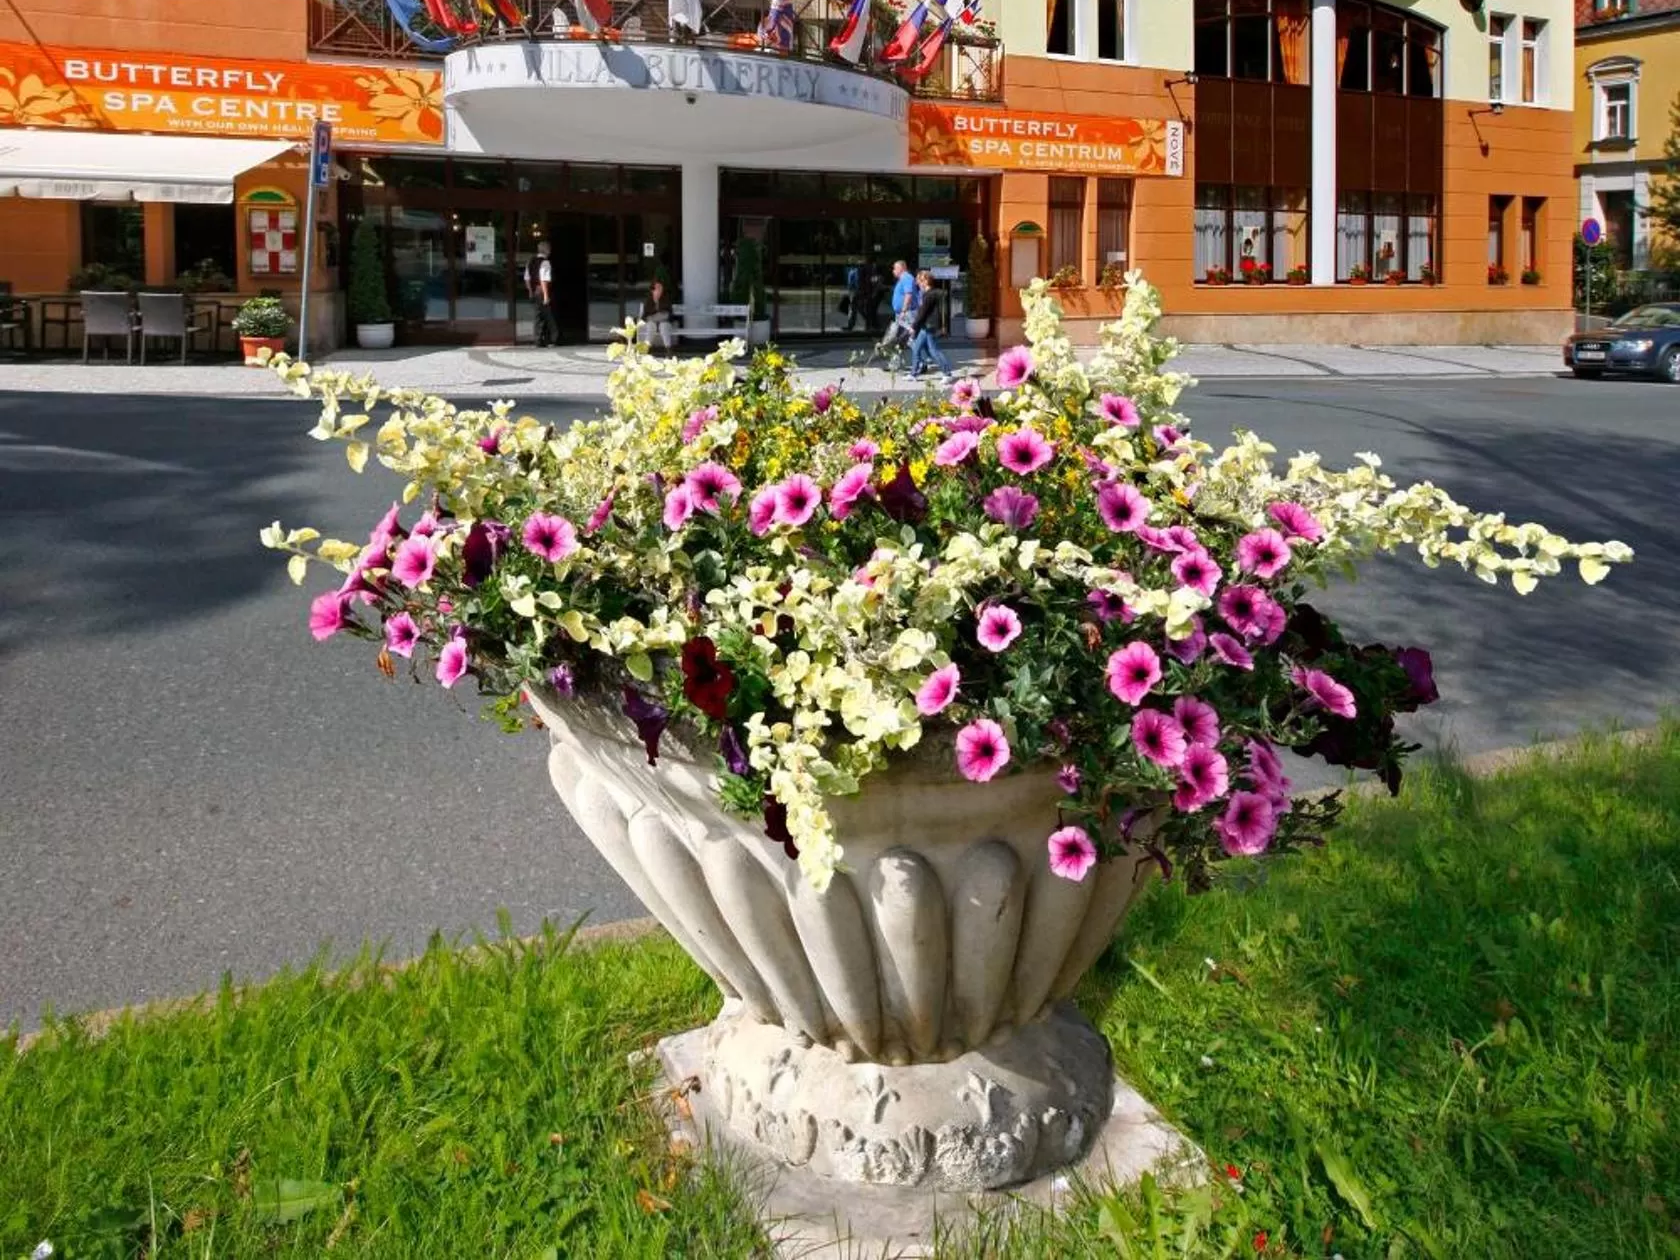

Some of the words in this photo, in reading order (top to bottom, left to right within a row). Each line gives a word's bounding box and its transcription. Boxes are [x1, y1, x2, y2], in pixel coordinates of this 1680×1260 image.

[64, 59, 285, 92] BUTTERFLY
[648, 53, 821, 101] BUTTERFLY
[103, 91, 177, 114] SPA
[191, 95, 343, 122] CENTRE
[167, 119, 202, 129] WITH
[206, 120, 235, 130] OUR
[238, 122, 268, 131] OWN
[332, 125, 377, 137] SPRING
[953, 114, 1078, 139] BUTTERFLY
[969, 140, 1011, 156] SPA
[1019, 142, 1122, 161] CENTRUM
